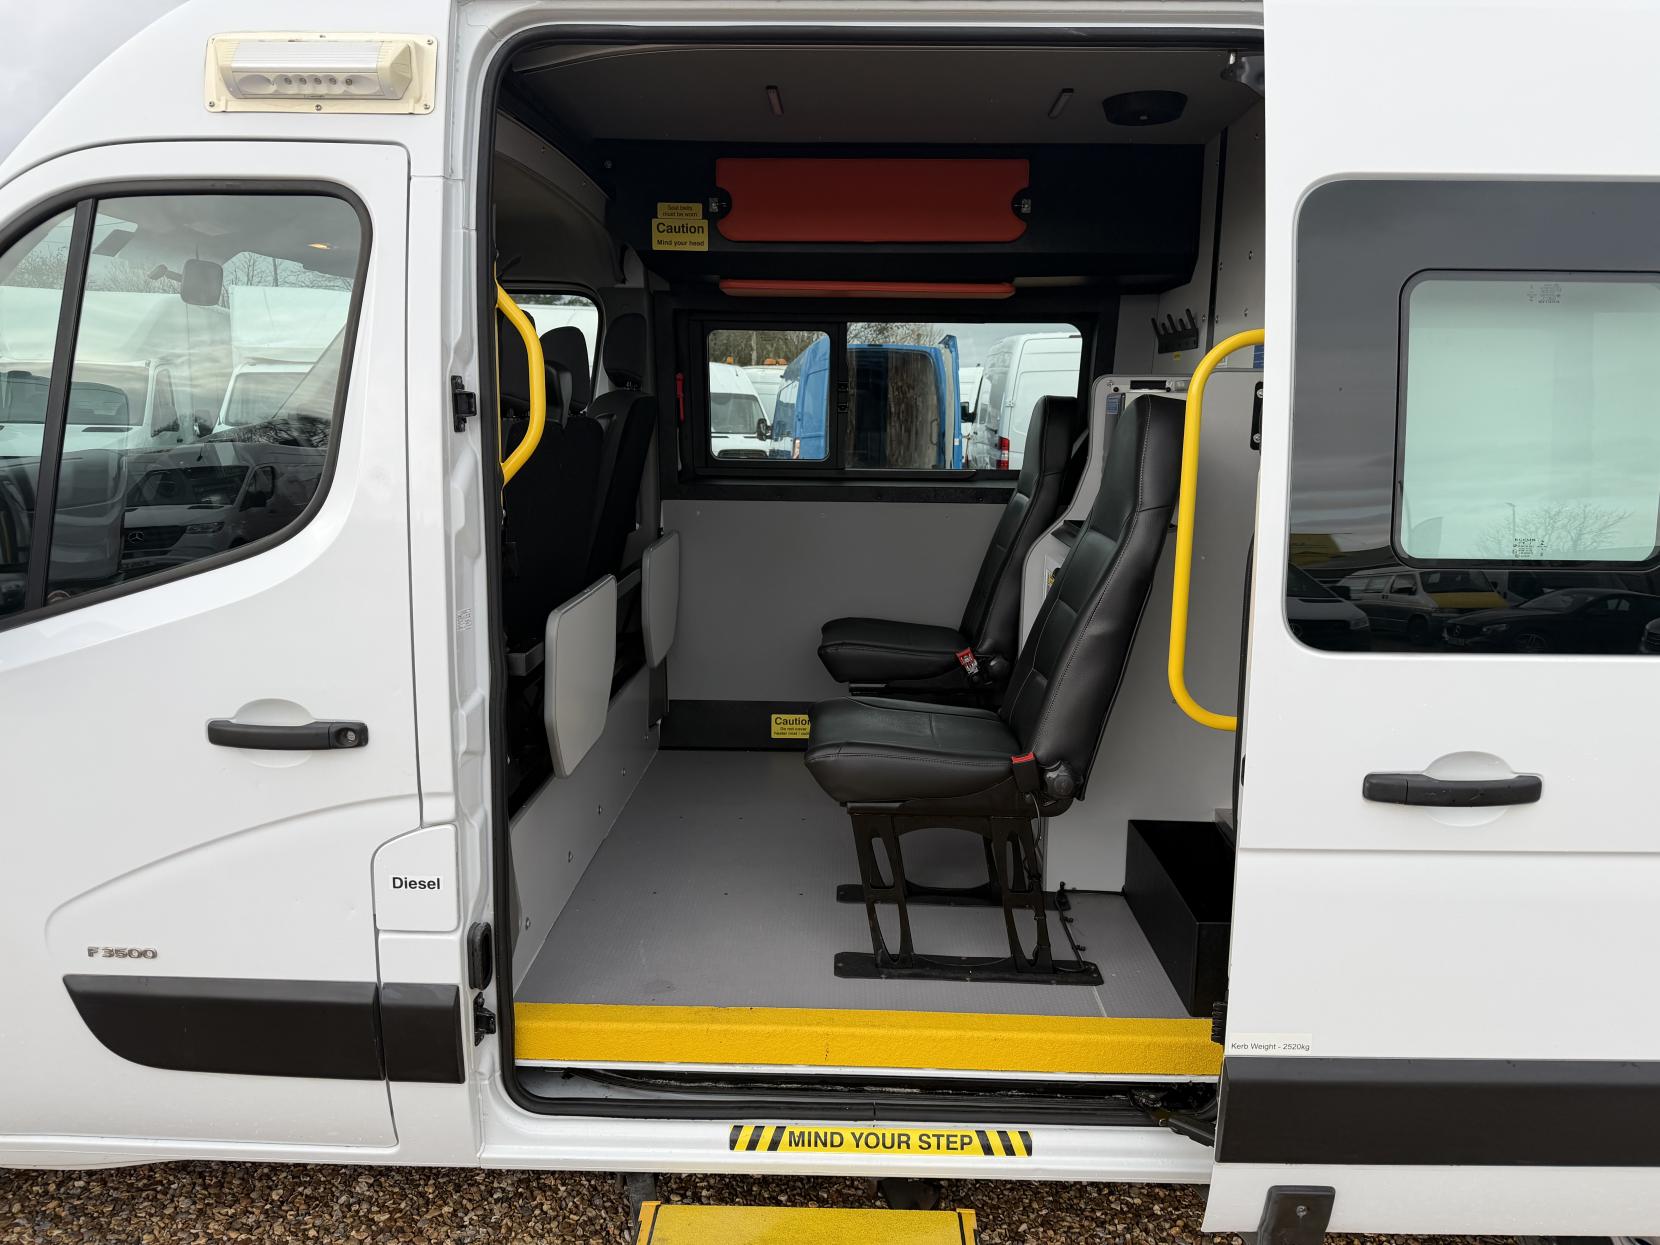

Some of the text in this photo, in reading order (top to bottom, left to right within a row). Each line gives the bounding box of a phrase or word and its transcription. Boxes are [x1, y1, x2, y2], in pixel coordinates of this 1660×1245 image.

[657, 223, 704, 234] Caution
[392, 876, 441, 890] Diesel
[1231, 1042, 1249, 1050] Kerb
[1250, 1043, 1276, 1051] Weight
[1282, 1043, 1310, 1051] 2520kg
[787, 1130, 974, 1151] MIND YOUR STEP
